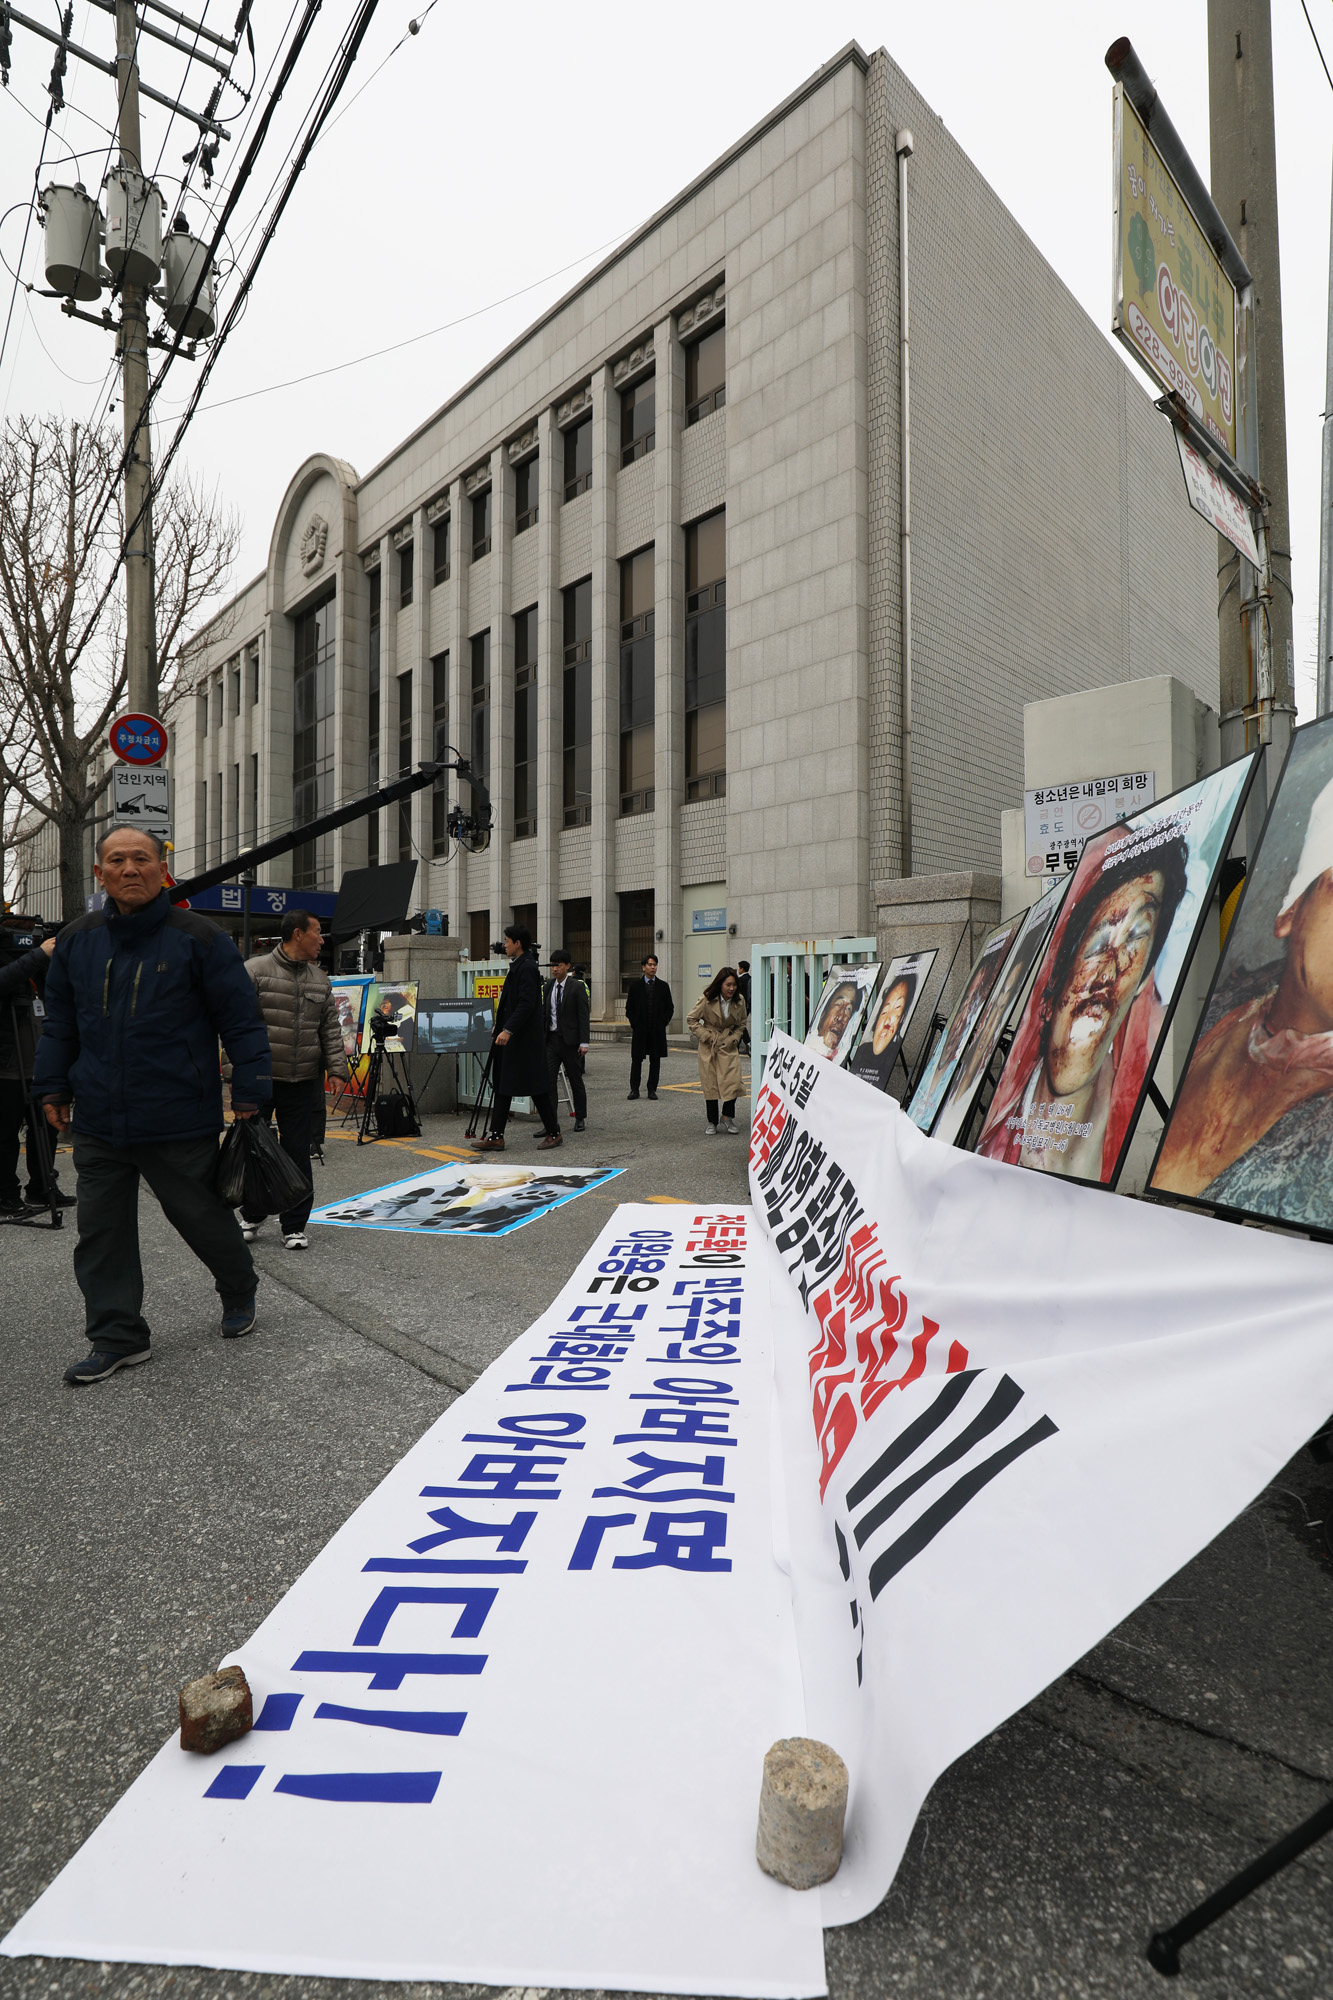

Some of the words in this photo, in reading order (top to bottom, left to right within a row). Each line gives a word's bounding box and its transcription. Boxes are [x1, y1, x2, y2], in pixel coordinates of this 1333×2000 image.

[1127, 162, 1147, 200] 꿈이
[1149, 192, 1176, 248] 커가는
[1177, 234, 1226, 344] 꿈나무
[1135, 314, 1198, 410] 228-9957
[1157, 262, 1233, 426] 어린이집
[1208, 418, 1228, 449] 150m
[1184, 440, 1247, 526] 주차장
[117, 773, 167, 787] 견인지역
[119, 733, 159, 746] 주정차금지
[1034, 785, 1080, 806] 청소년은
[1082, 778, 1118, 797] 내일의
[1122, 774, 1148, 790] 희망
[18, 937, 33, 946] jtb
[789, 1061, 820, 1111] 5월
[586, 1229, 674, 1295] 이완용은
[678, 1213, 748, 1269] 전두환이
[504, 1302, 648, 1393] 근대화의
[645, 1276, 745, 1364] 민주주의
[566, 1376, 740, 1573] 아버지면
[202, 1412, 588, 1805] 아버지다!!
